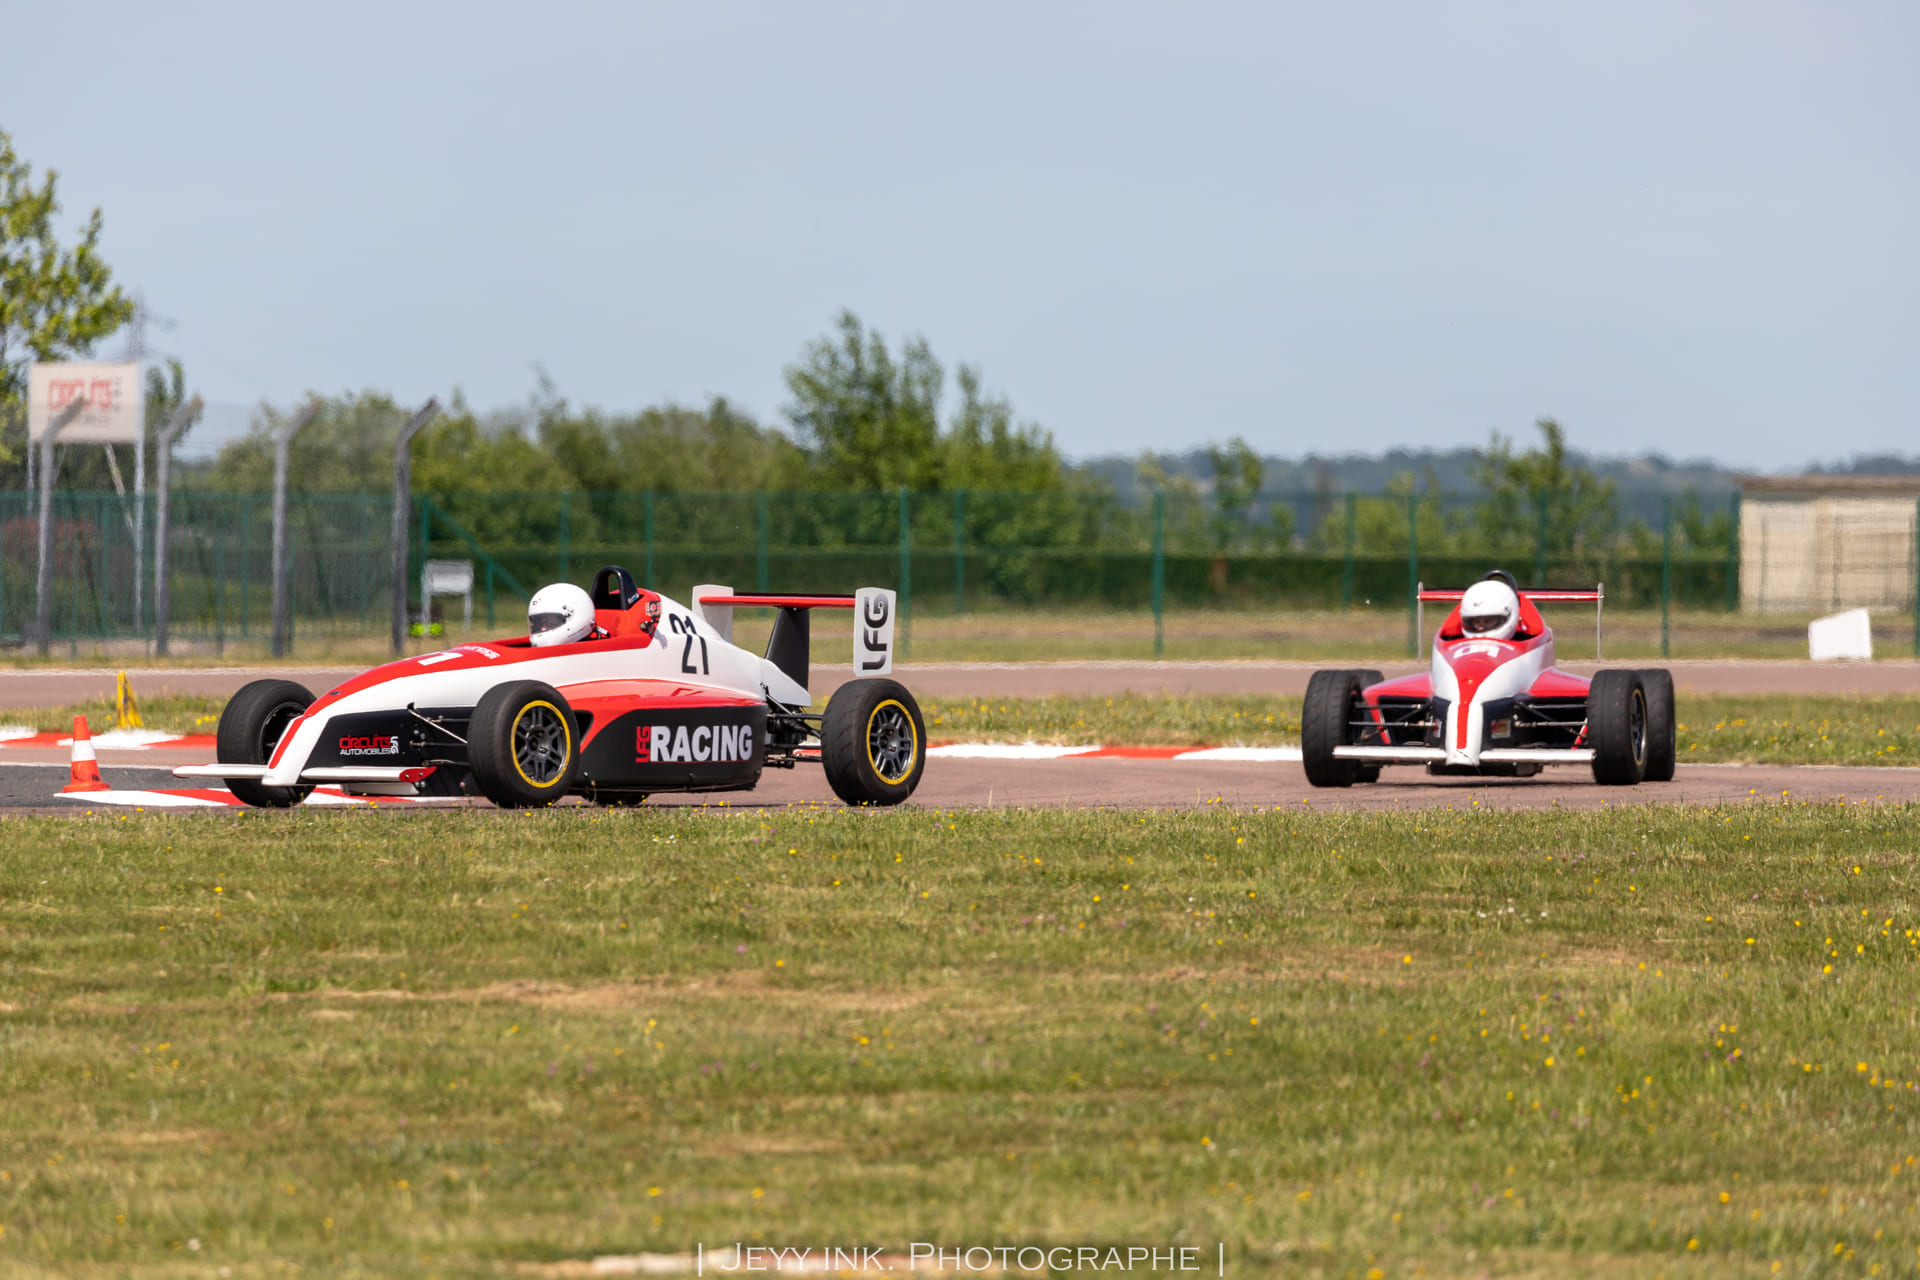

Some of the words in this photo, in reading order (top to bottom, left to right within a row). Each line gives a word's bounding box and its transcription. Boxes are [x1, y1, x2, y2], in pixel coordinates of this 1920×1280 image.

[668, 612, 710, 675] 21
[862, 593, 889, 671] LFG
[635, 725, 650, 763] LFG
[650, 724, 753, 762] RACING
